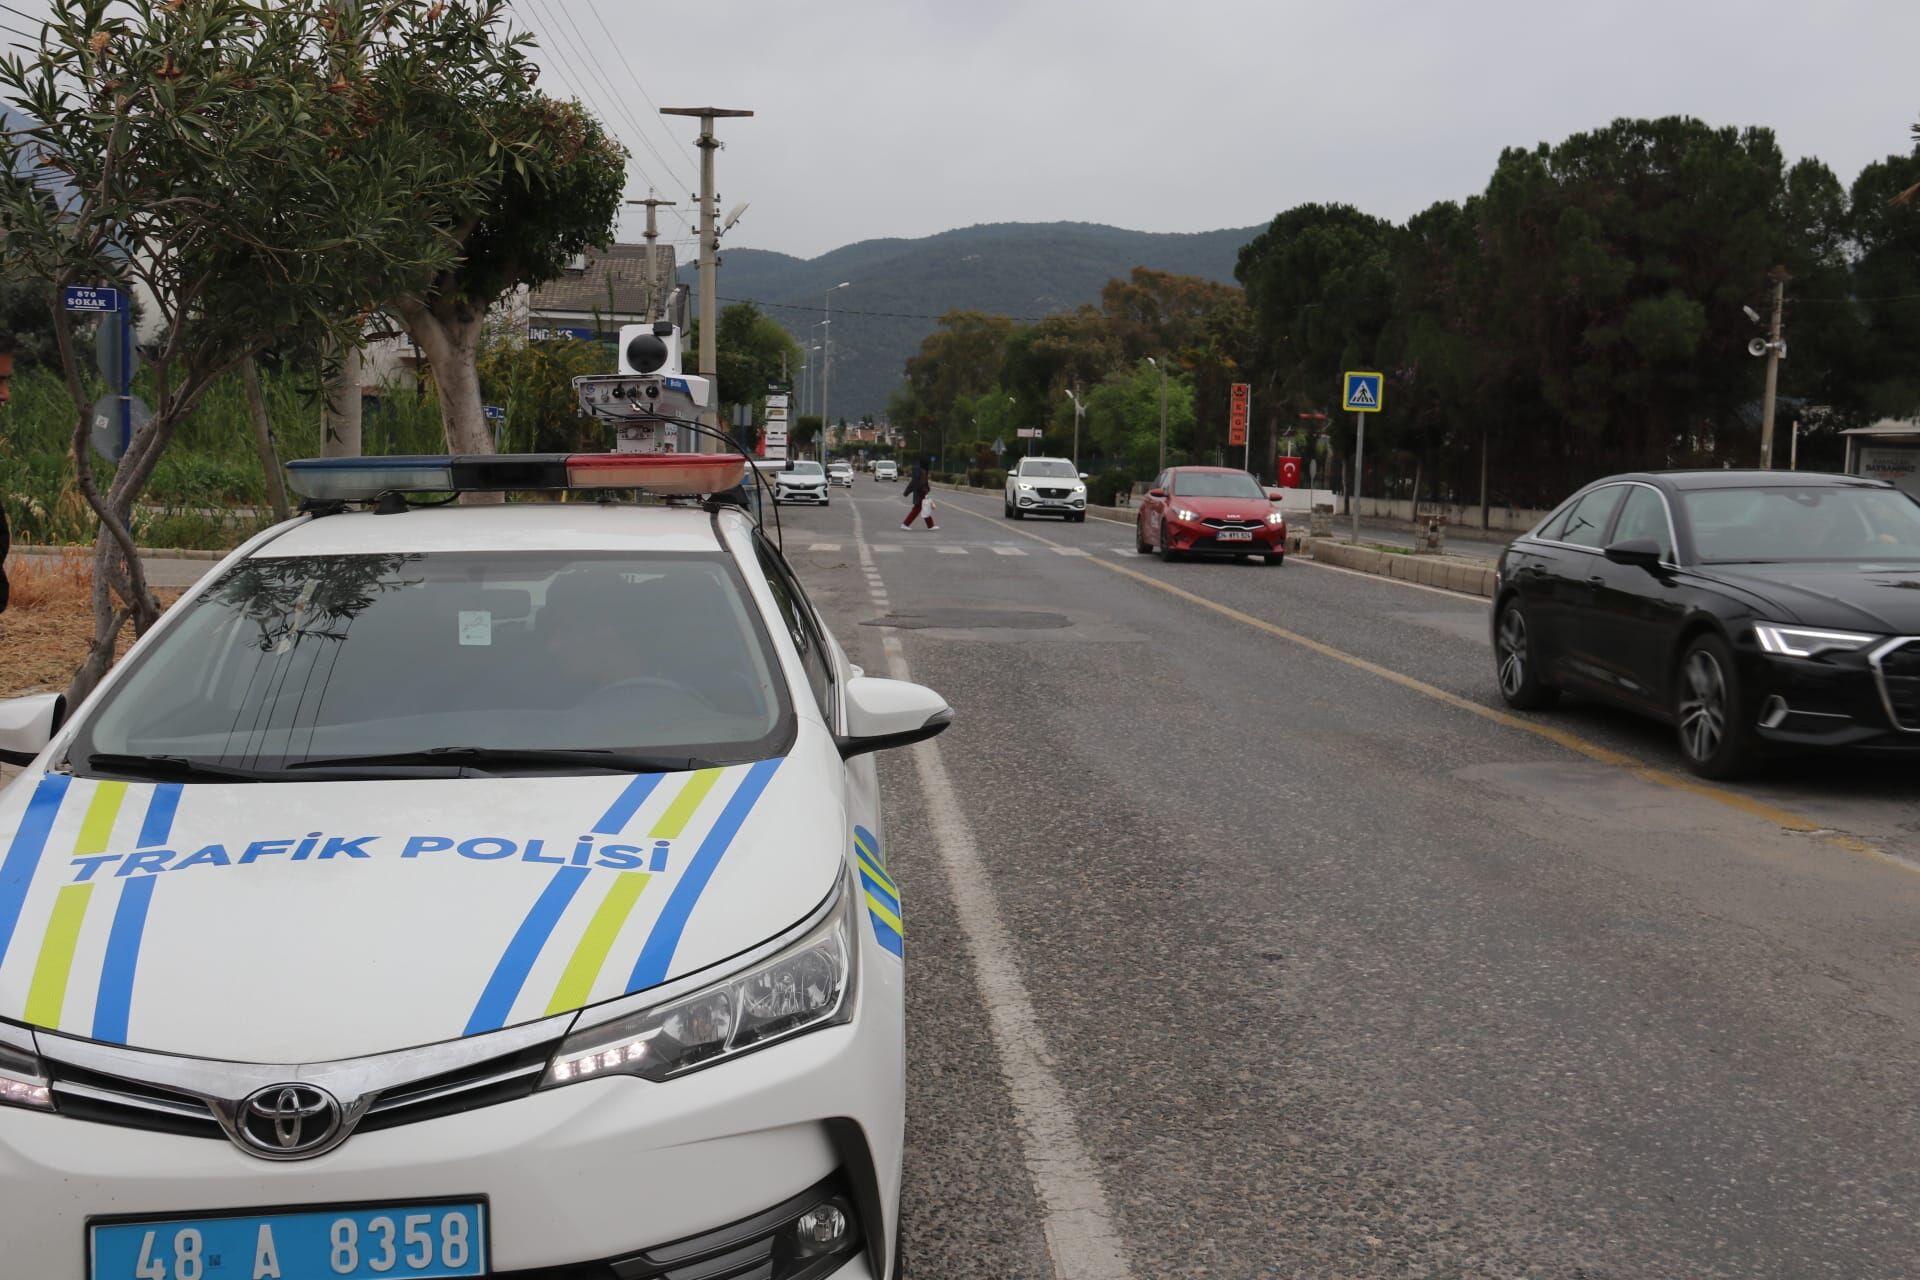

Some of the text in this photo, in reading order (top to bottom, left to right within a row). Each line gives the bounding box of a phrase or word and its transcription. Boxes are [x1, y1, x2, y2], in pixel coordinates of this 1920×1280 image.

[67, 298, 106, 306] SOKAK
[69, 831, 671, 882] TRAFİK POLİSİ
[136, 1211, 469, 1280] 48 A 8358
